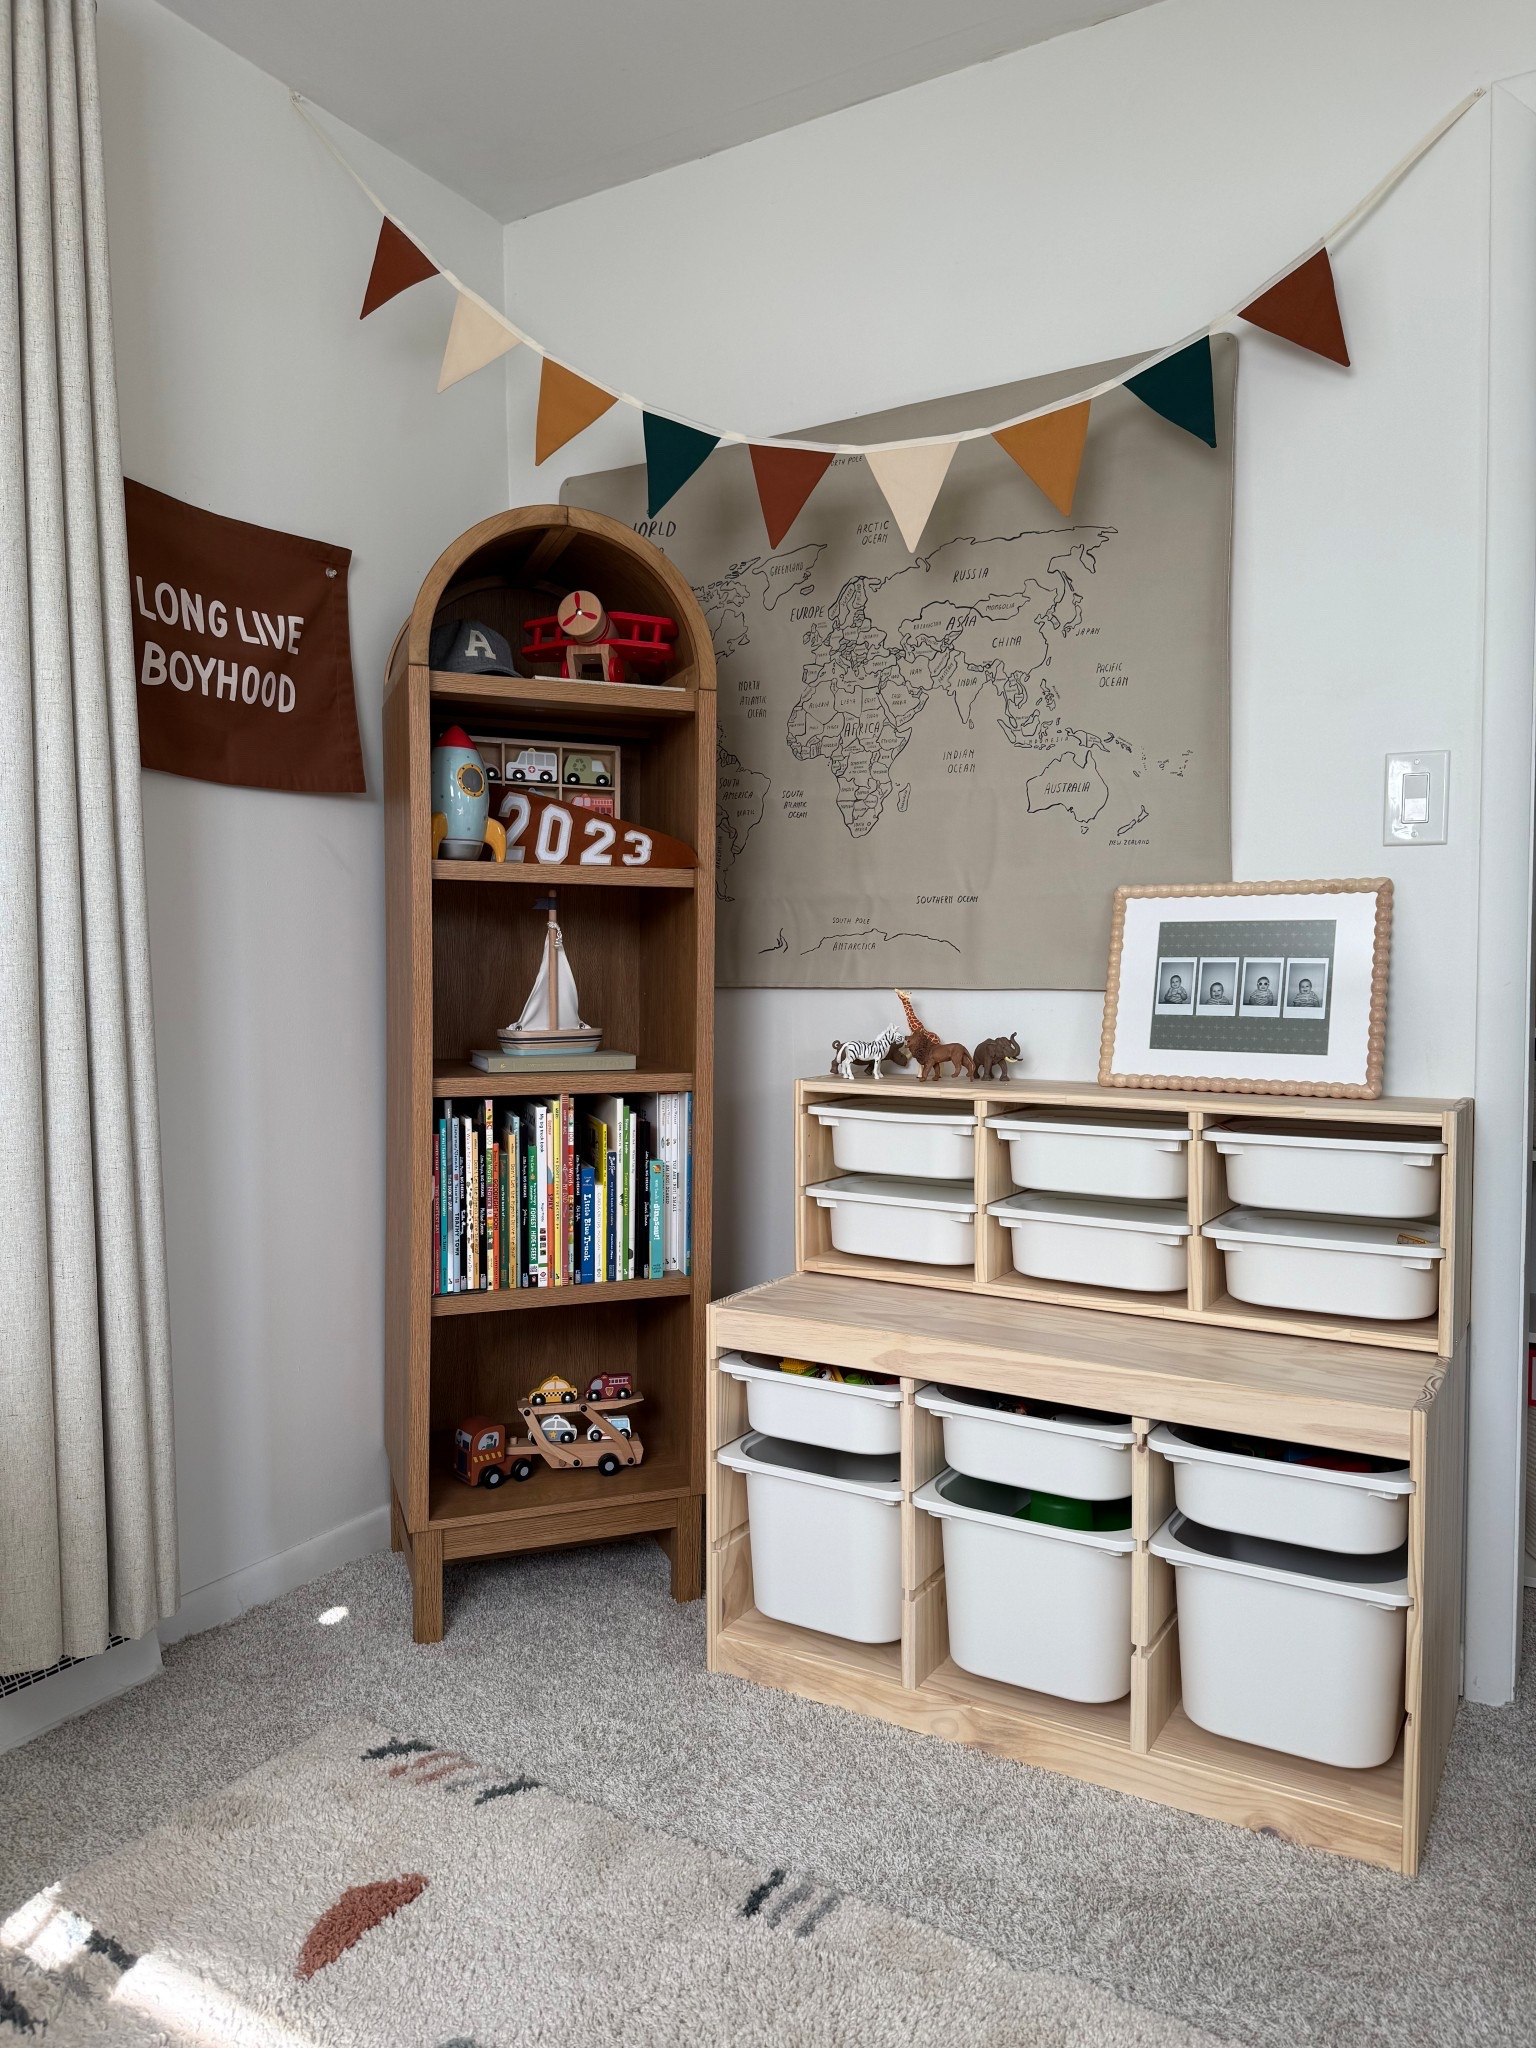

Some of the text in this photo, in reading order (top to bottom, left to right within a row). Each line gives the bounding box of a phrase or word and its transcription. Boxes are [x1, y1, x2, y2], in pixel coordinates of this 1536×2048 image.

[830, 455, 863, 467] ORTH POLE
[856, 520, 890, 535] ARCTIC
[861, 533, 889, 545] OCEAN
[769, 561, 804, 577] GREENLAND
[952, 567, 989, 583] RUSSIA
[790, 605, 826, 621] EUROPE
[985, 603, 1015, 612] MONGOLIA
[135, 575, 304, 655] LONG LIVE
[945, 615, 977, 631] ASIA
[1075, 627, 1101, 637] JAPAN
[464, 629, 497, 660] A
[991, 636, 1022, 649] CHINA
[1096, 662, 1123, 674] PACIFIC
[141, 641, 296, 713] BOYHOOD
[957, 677, 978, 687] INDIA
[1098, 676, 1129, 688] OCEAN
[738, 680, 761, 692] NORTH
[739, 695, 767, 706] ATLANTIC
[747, 707, 767, 719] OCEAN
[843, 722, 880, 738] AFRICA
[942, 749, 975, 761] INDIAN
[947, 763, 976, 774] OCEAN
[719, 776, 740, 790] SOUTH
[1044, 782, 1091, 795] AUSTRALIA
[722, 790, 754, 800] AMERICA
[782, 790, 804, 799] SOUTH
[783, 800, 808, 809] ATLANTIC
[787, 810, 808, 819] OCEAN
[491, 792, 652, 866] 2023
[915, 894, 979, 905] SOUTHERN OCEAN
[832, 916, 871, 925] SOUTH POLE
[832, 941, 877, 952] ANTARCTICA
[563, 1183, 568, 1191] MY
